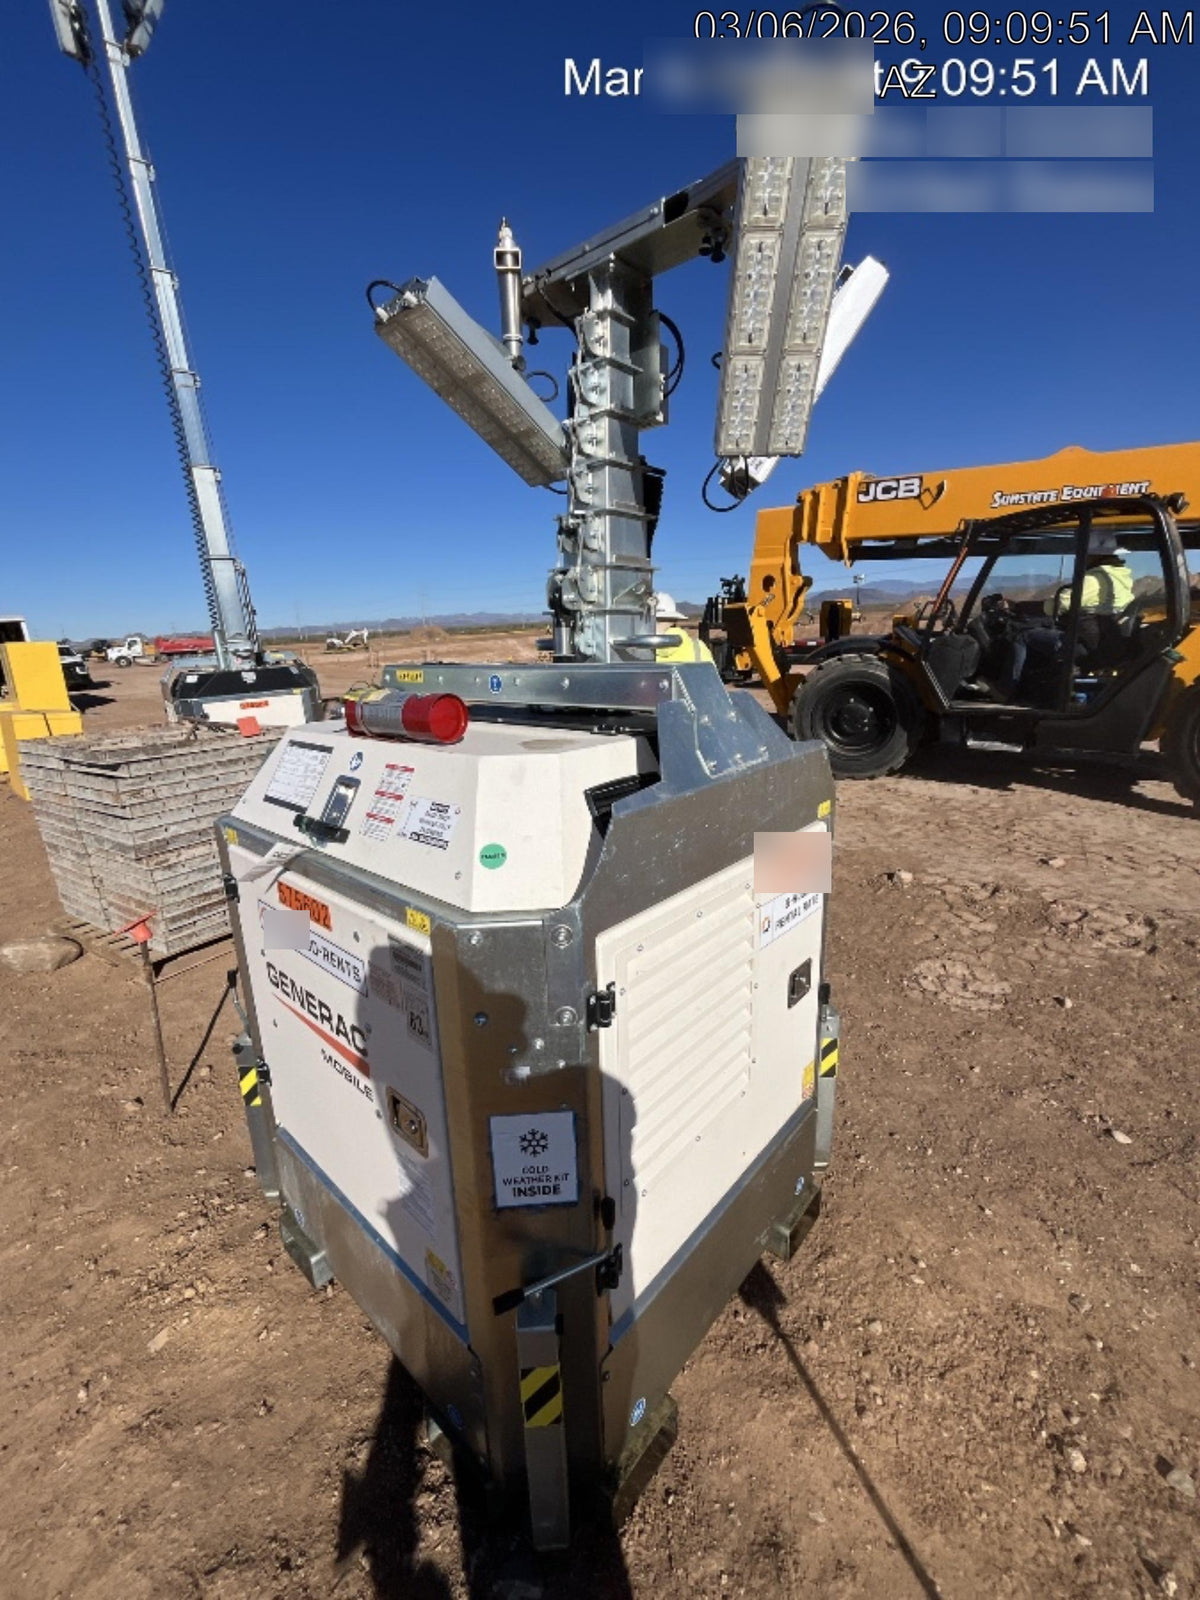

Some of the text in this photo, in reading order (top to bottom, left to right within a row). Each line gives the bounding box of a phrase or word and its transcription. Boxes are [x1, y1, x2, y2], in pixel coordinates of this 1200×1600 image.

[858, 477, 921, 502] JCB
[266, 961, 369, 1058] GENERAC
[321, 1048, 374, 1102] MOBILE
[502, 1172, 570, 1186] WEATHER KIT
[522, 1165, 549, 1174] COLD
[512, 1184, 561, 1197] INSIDE
